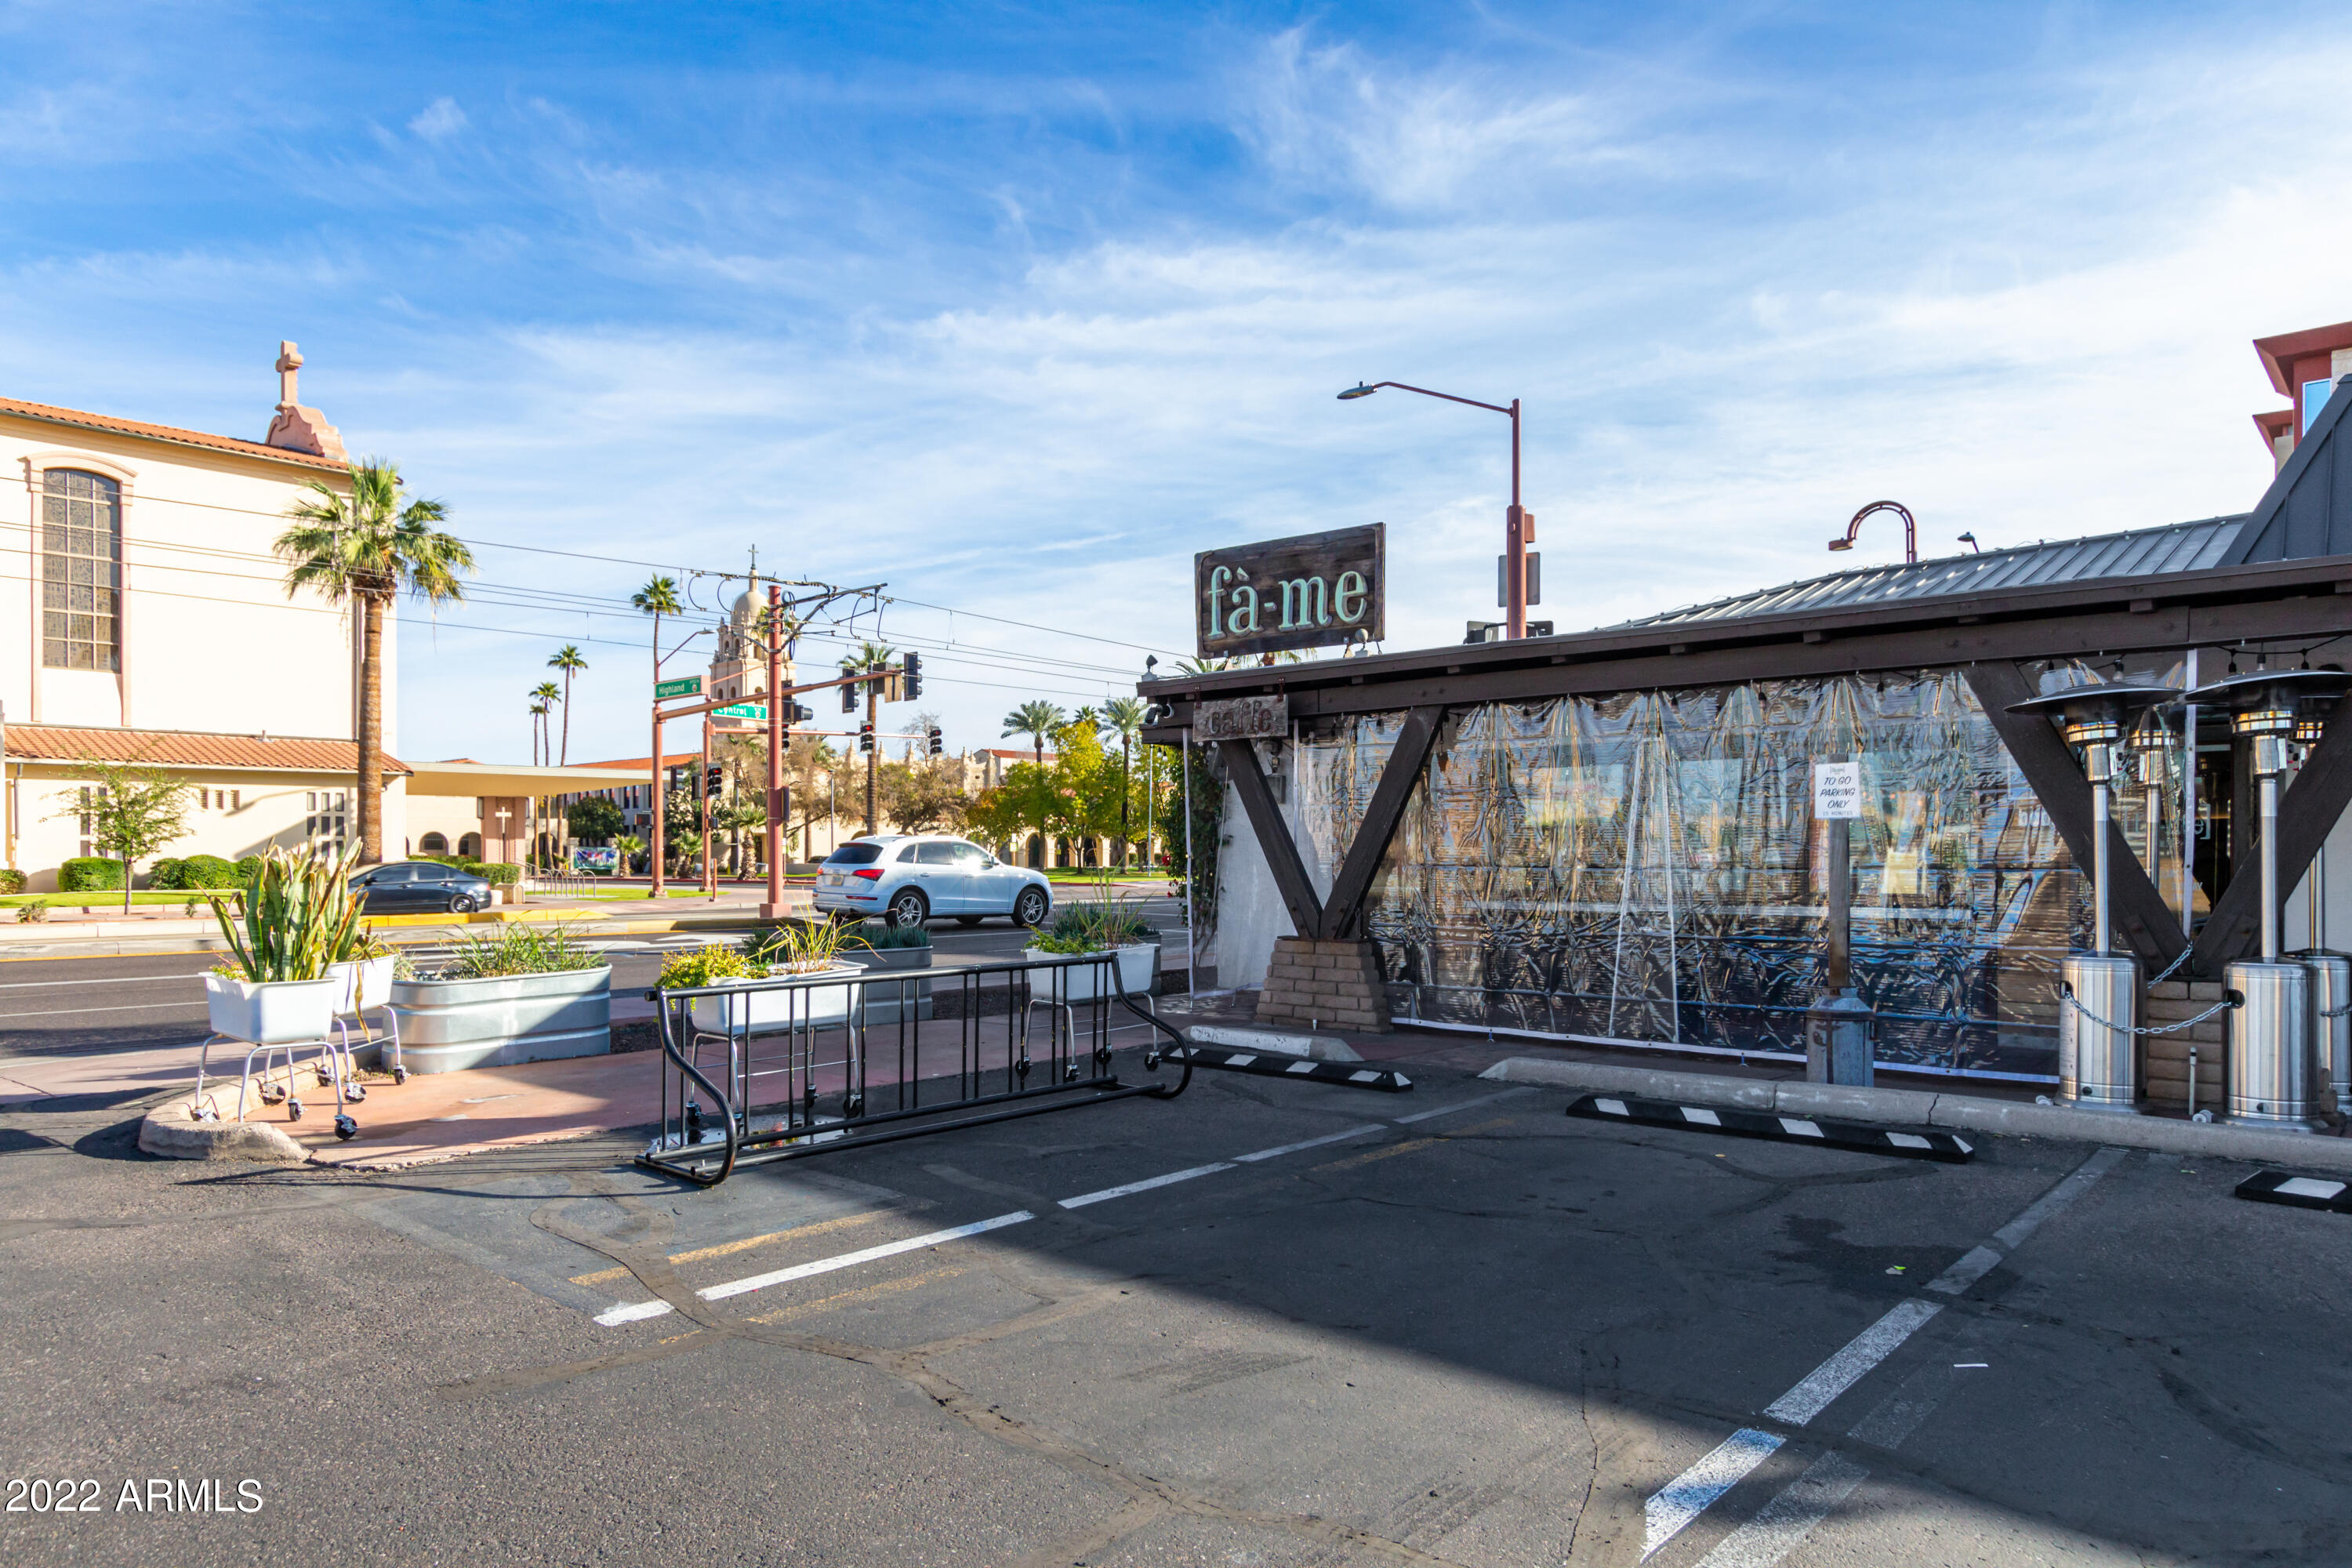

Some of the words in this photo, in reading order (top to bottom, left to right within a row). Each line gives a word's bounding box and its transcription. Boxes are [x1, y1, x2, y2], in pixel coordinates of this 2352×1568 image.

[1207, 565, 1367, 640] fà-me
[659, 683, 684, 696] Highland
[1824, 777, 1836, 786] TO
[1838, 775, 1852, 785] GO
[1819, 787, 1856, 797] PARKING
[1827, 800, 1850, 808] ONLY
